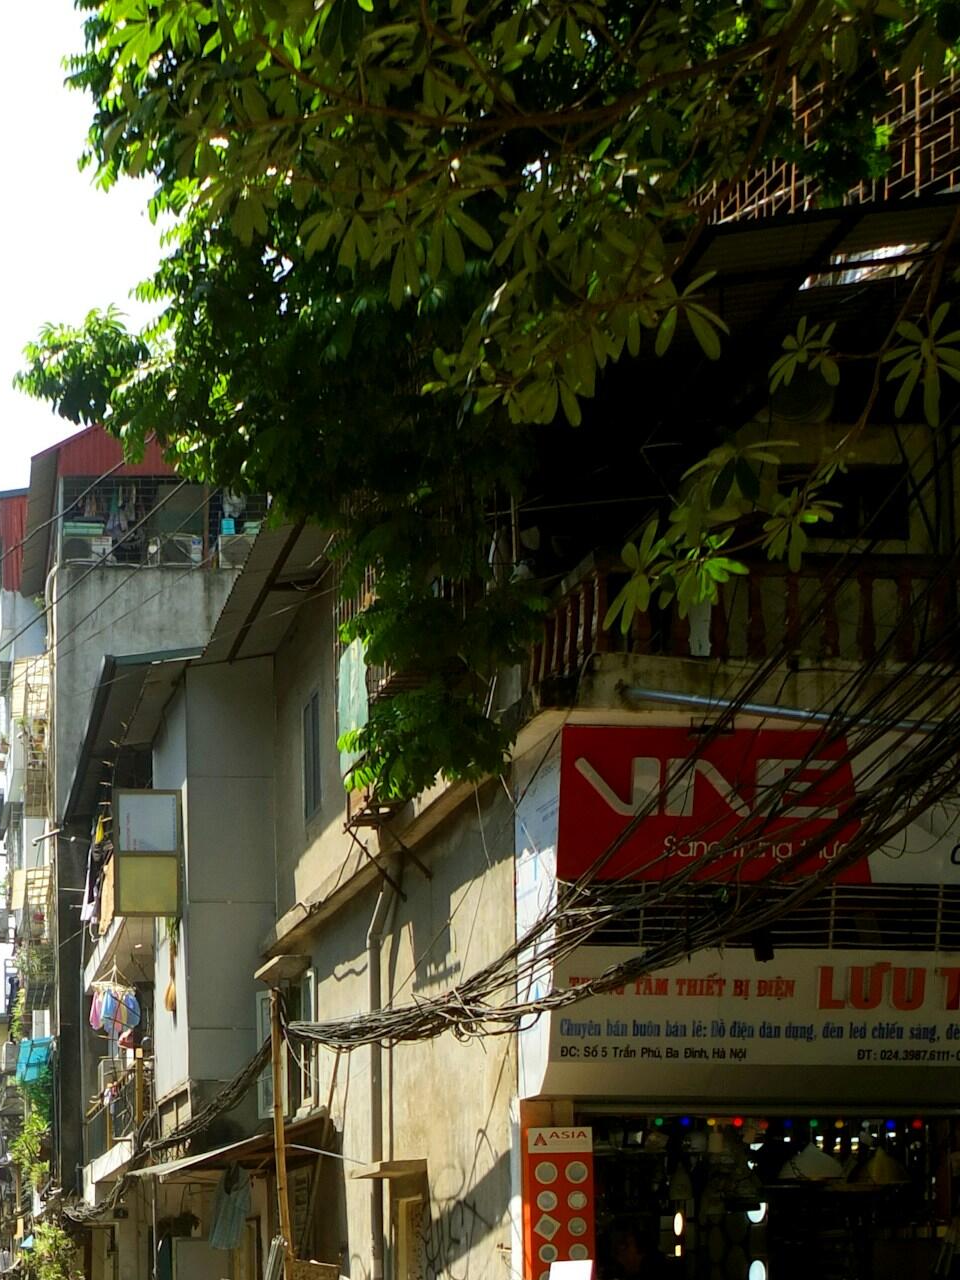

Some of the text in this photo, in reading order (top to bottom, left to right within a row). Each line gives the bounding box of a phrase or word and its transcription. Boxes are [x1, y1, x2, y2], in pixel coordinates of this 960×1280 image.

[676, 972, 726, 997] THIẾT
[732, 977, 751, 1001] BỊ
[755, 975, 796, 1001] ĐIỆN
[817, 961, 927, 1011] LƯU
[600, 1046, 608, 1058] 5
[665, 1047, 679, 1058] Ba
[712, 1046, 726, 1059] Hà
[729, 1047, 747, 1062] Nội
[549, 1130, 588, 1140] ASIA
